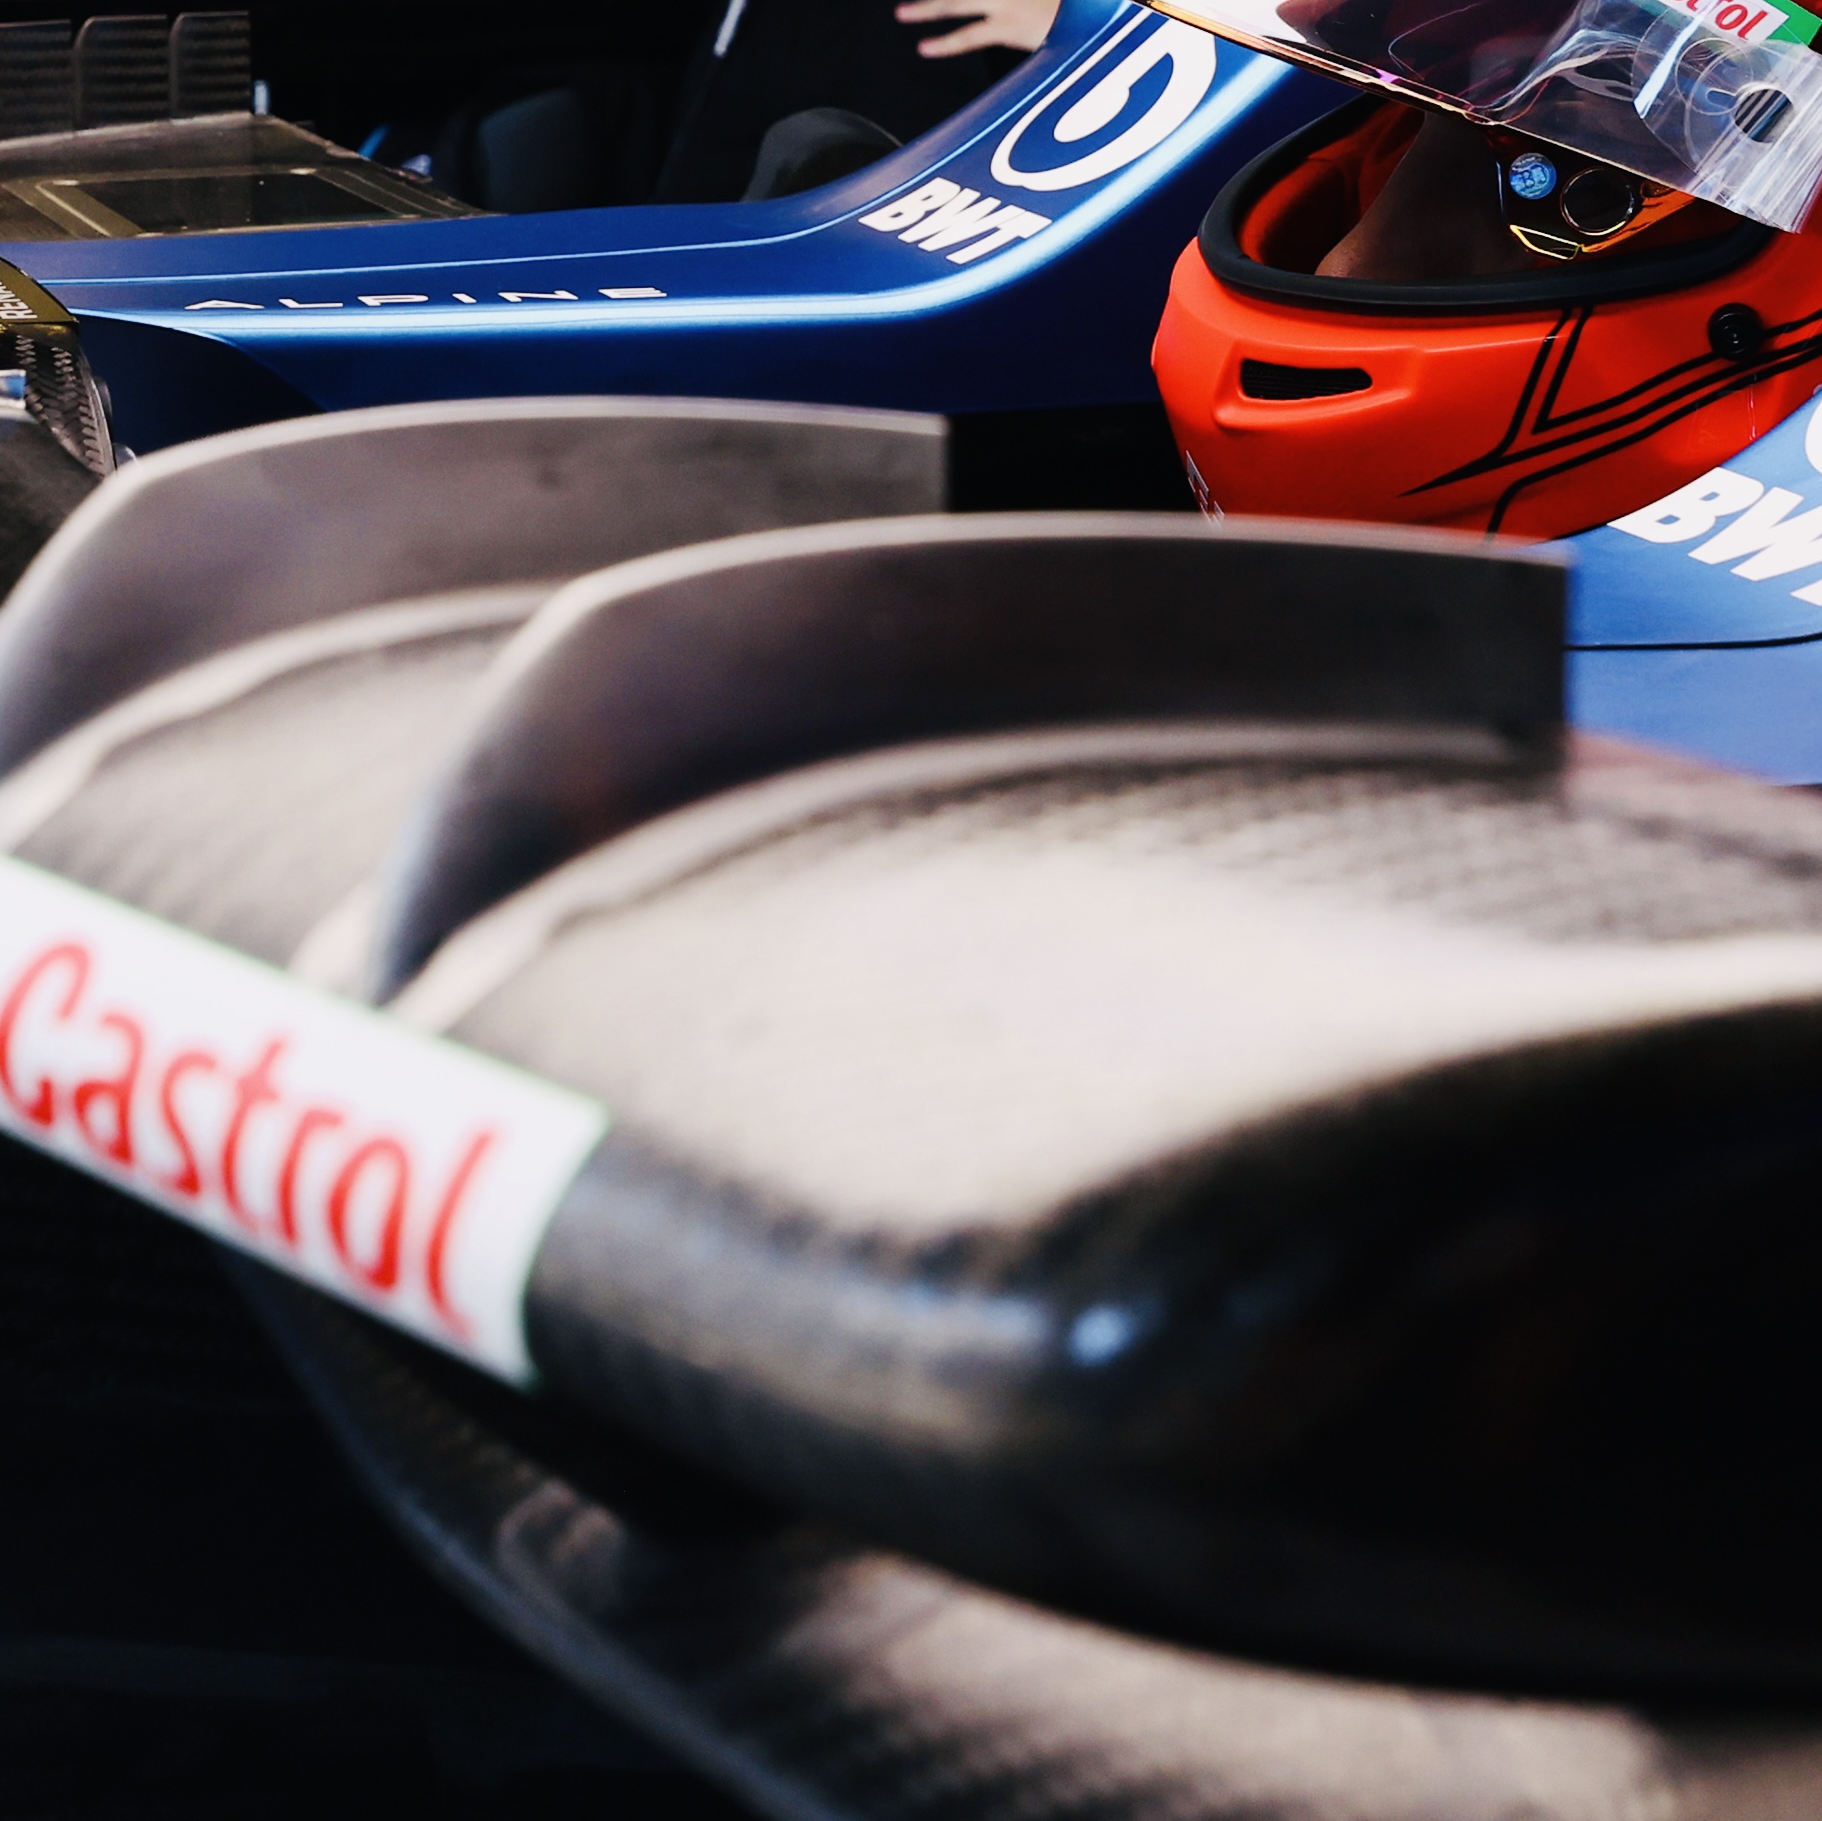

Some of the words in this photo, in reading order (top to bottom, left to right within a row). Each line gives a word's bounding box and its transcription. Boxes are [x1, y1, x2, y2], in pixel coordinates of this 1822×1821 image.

[858, 177, 1053, 265] BWT
[184, 286, 668, 311] ALPINE
[0, 940, 502, 1350] Castrol
